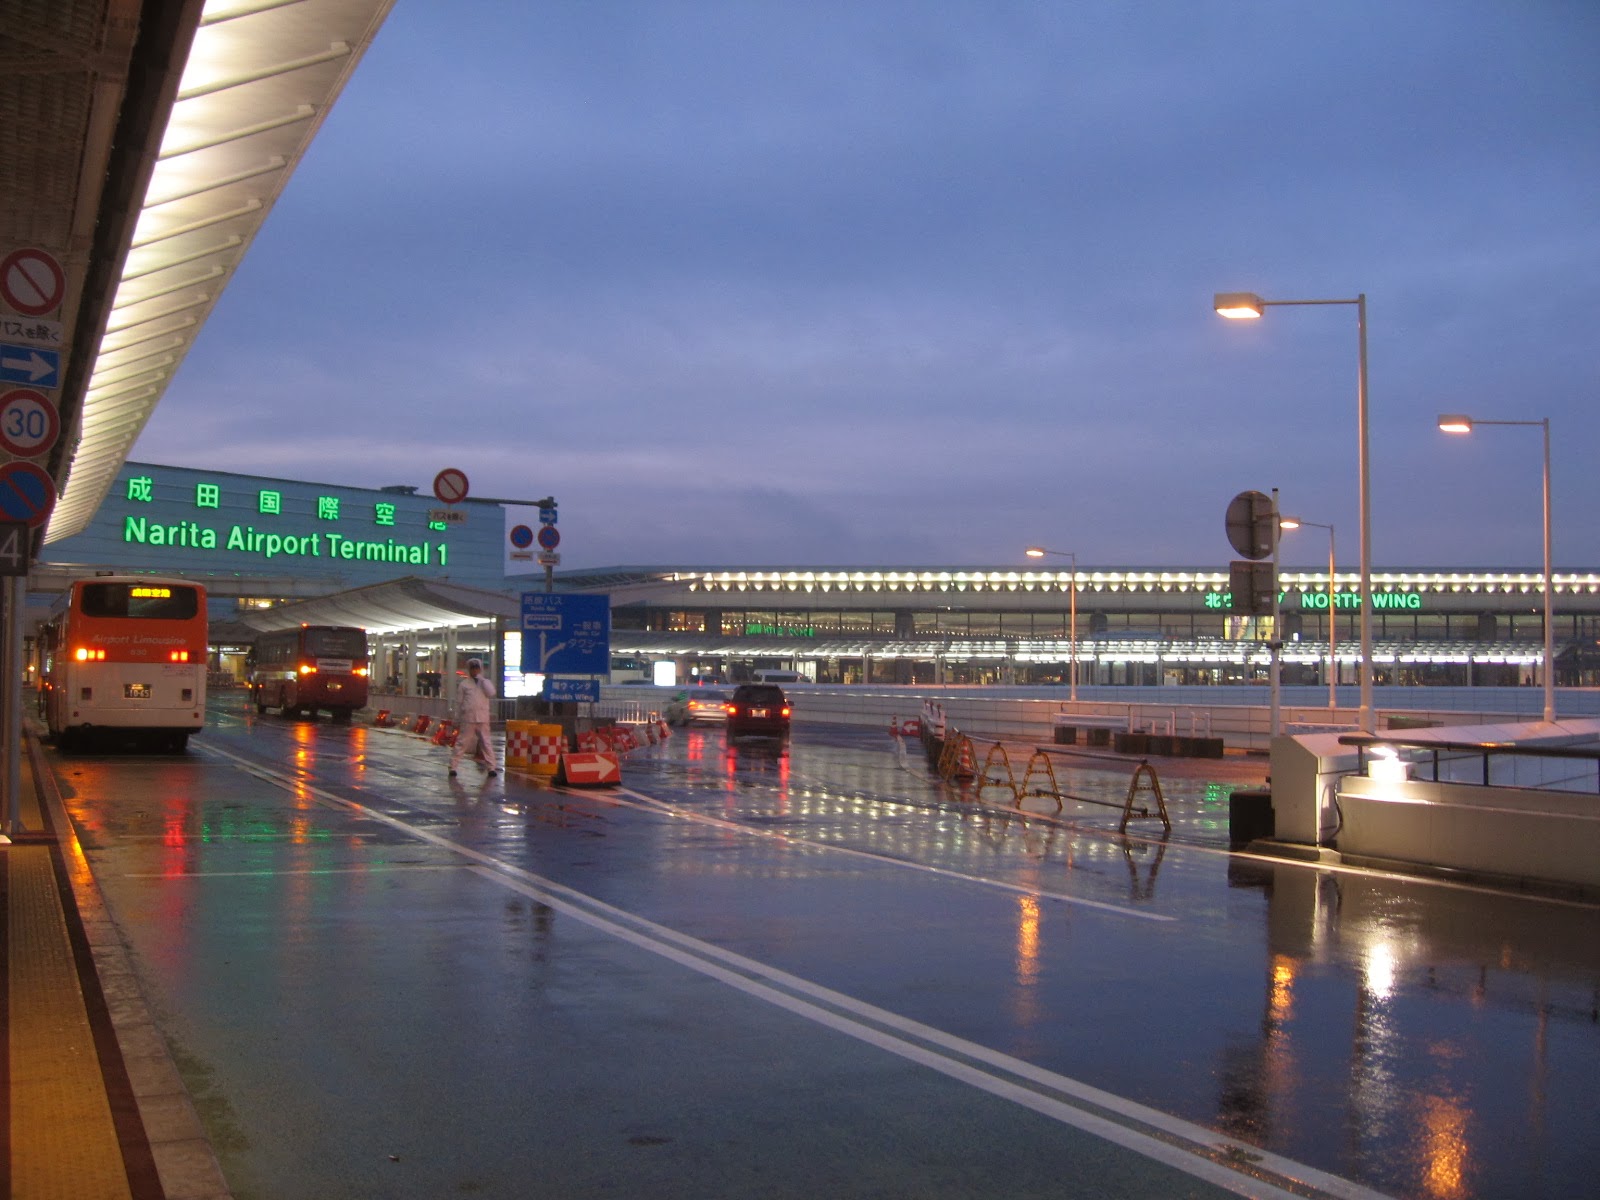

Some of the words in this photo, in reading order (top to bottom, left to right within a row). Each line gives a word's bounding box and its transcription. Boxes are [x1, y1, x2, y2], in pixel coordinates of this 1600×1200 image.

[6, 408, 45, 439] 30
[125, 516, 216, 549] Narita
[227, 525, 319, 558] Airport
[325, 533, 429, 565] Terminal
[436, 543, 447, 566] 1
[1301, 593, 1362, 608] NORTH
[1371, 593, 1421, 608] WING
[92, 634, 130, 645] Airport
[133, 634, 187, 645] Limousine
[575, 694, 594, 702] Wing
